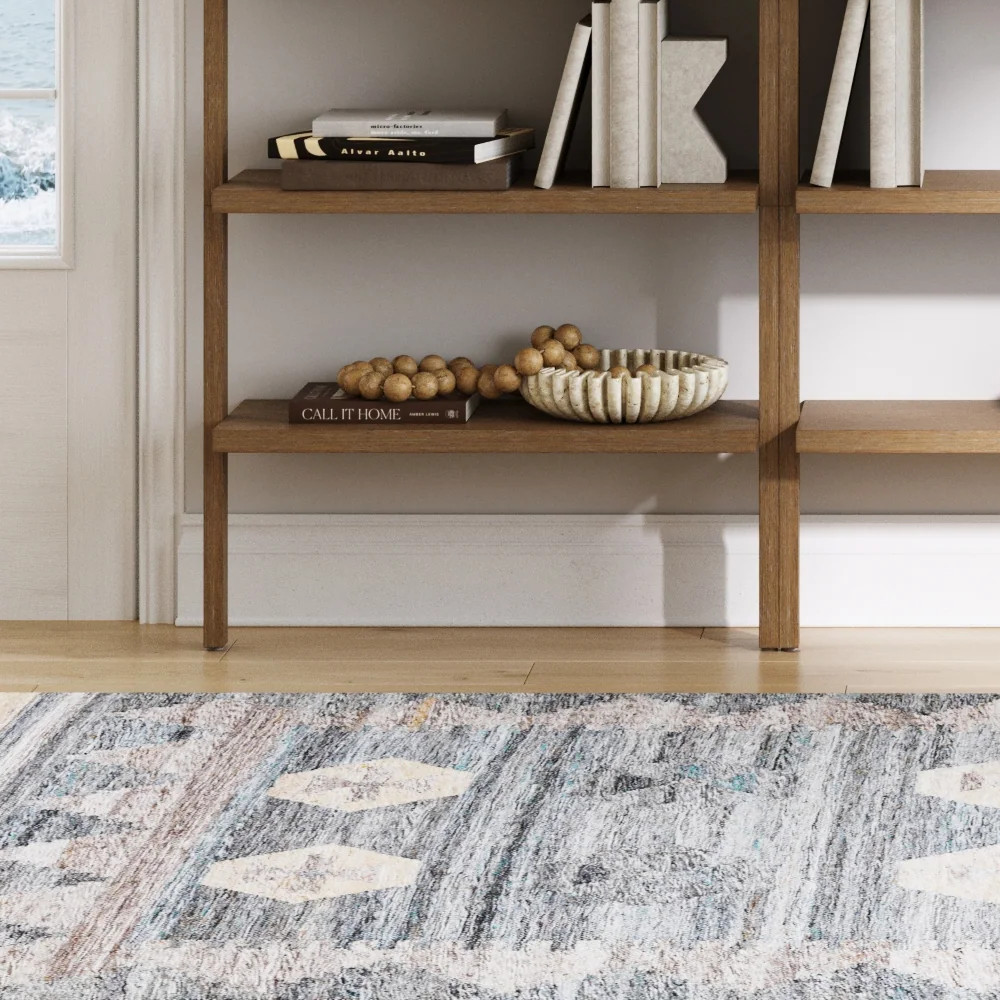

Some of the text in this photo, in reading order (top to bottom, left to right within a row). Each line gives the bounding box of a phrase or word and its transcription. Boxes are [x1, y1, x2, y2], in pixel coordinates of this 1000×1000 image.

[341, 148, 426, 157] Alvar Aalto
[301, 408, 402, 420] CALL IT HOME
